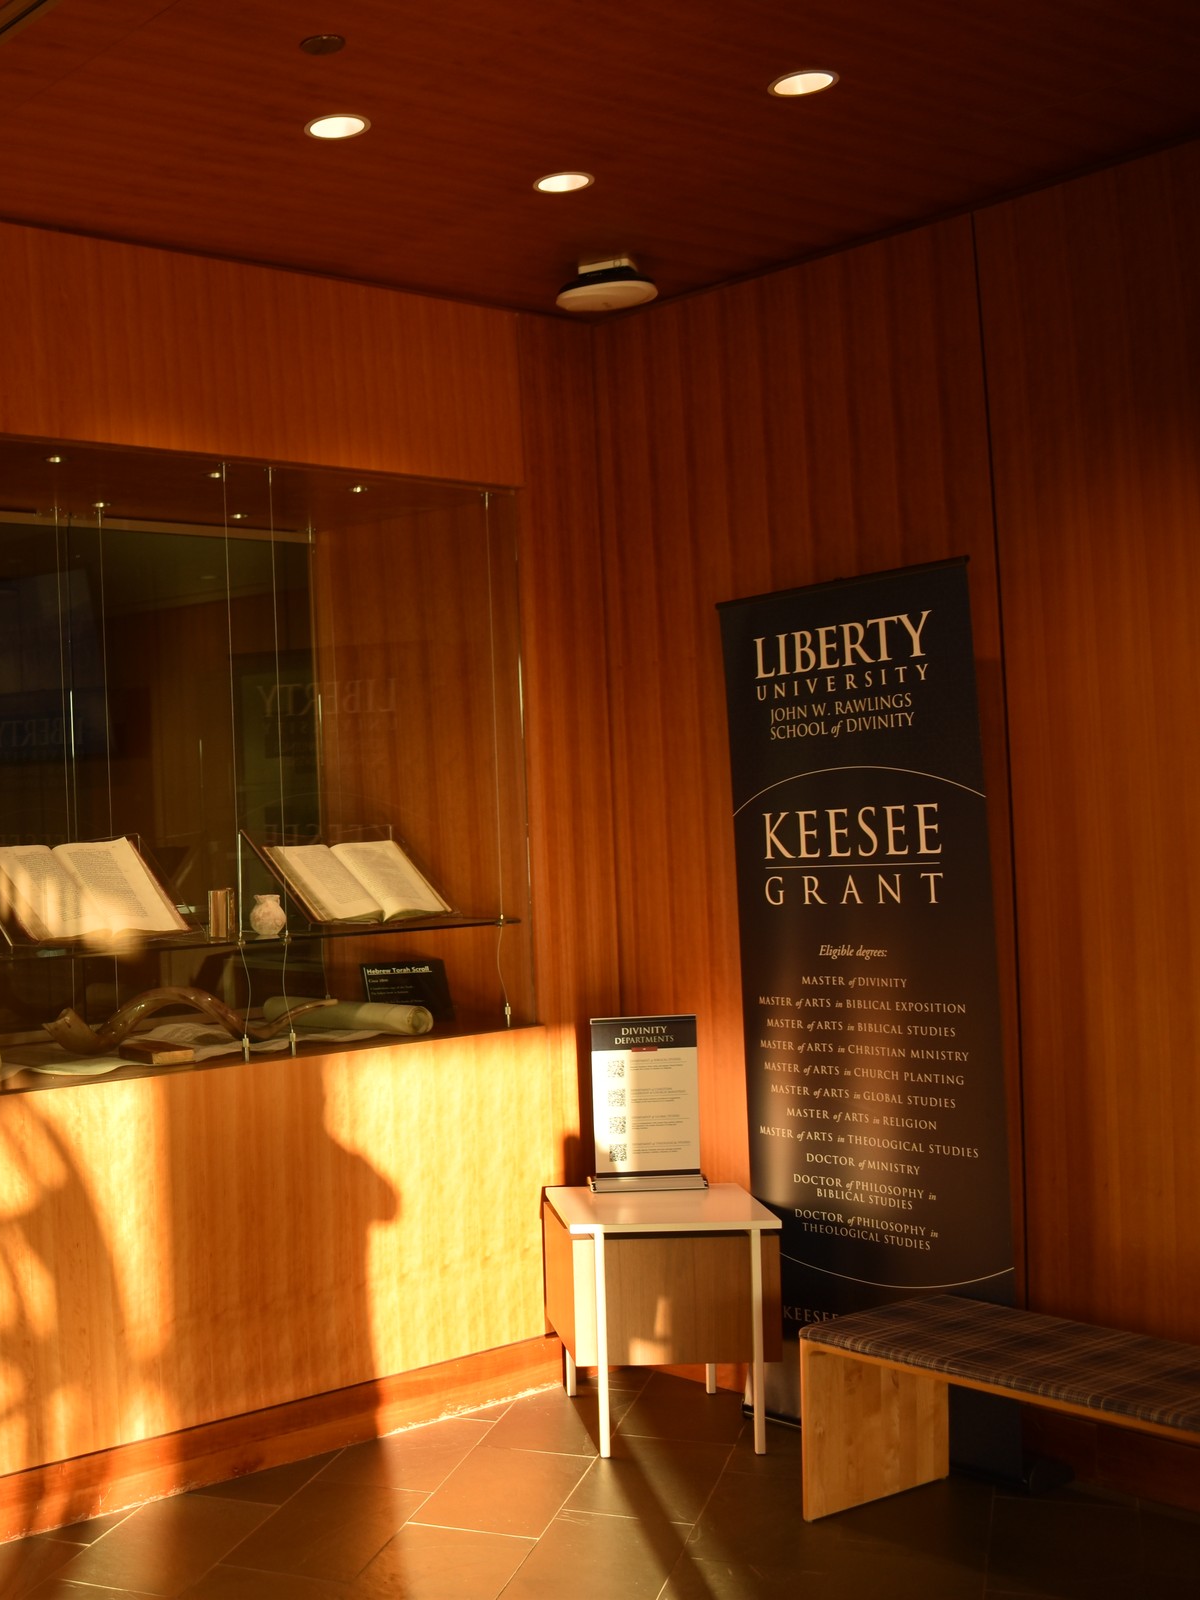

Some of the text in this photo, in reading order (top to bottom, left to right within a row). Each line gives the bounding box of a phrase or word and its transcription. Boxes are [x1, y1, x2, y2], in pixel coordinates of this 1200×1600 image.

[753, 609, 932, 679] LIBERTY
[756, 663, 929, 701] UNIVERSITY
[770, 693, 912, 726] JOHN W. RAWLINGS
[770, 712, 914, 741] SCHOOL of DIVINITY
[763, 803, 942, 860] KEESEE
[765, 872, 943, 905] GRANT
[819, 945, 887, 959] Eligible degrees:
[802, 976, 907, 988] MASTER of DIVINITY
[759, 996, 966, 1014] MASTER of ARTS in BIBLICAL EXPOSITION
[615, 1035, 674, 1044] DEPARTMENTS
[622, 1026, 667, 1035] DIVINITY
[767, 1019, 956, 1037] MASTER of ARTS in BIBLICAL STUDIES
[760, 1040, 969, 1062] MASTER of ARTS in CHRISTIAN MINISTRY
[764, 1062, 964, 1085] MASTER of ARTS in CHURCH PLANTING
[771, 1084, 956, 1108] MASTER of ARTS in GLOBAL STUDIES
[787, 1107, 937, 1130] MASTER of ARTS in RELIGION
[760, 1126, 979, 1158] MASTER of ARTS in THEOLOGICAL STUDIES
[806, 1153, 920, 1175] DOCTOR of MINISTRY
[793, 1173, 936, 1200] DOCTOR of PHILOSOPHY in
[816, 1189, 913, 1210] BIBLICAL STUDIES
[795, 1209, 938, 1237] DOCTOR of PHILOSOPHY in
[802, 1222, 931, 1250] THEOLOGICAL STUDIES
